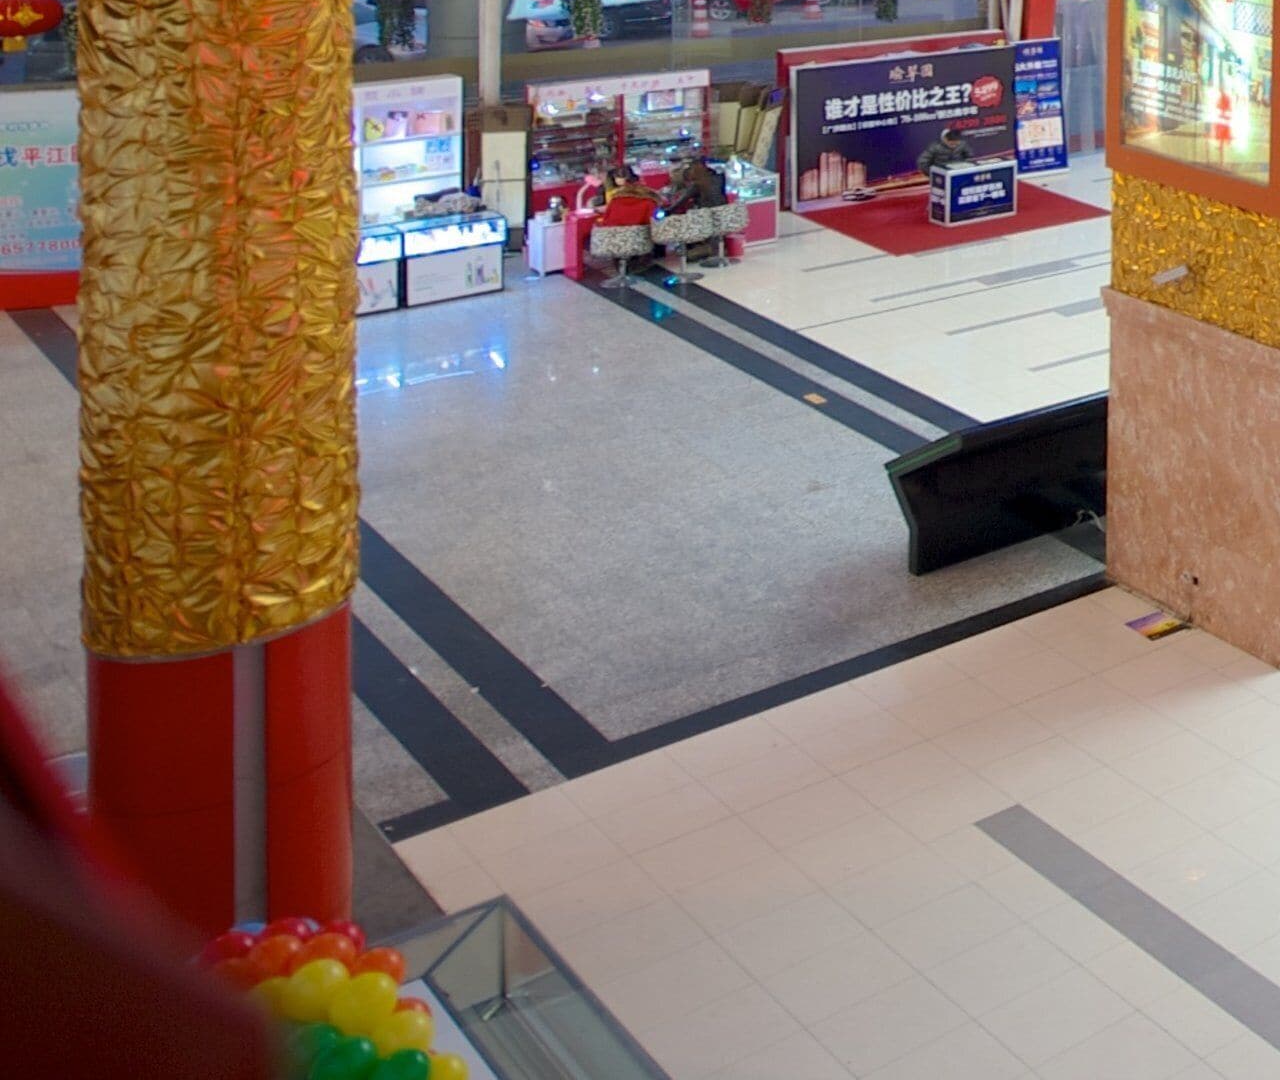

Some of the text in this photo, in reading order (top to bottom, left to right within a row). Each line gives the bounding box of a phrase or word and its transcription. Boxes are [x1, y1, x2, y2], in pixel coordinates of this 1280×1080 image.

[824, 83, 973, 120] 谁才是性价比之王?
